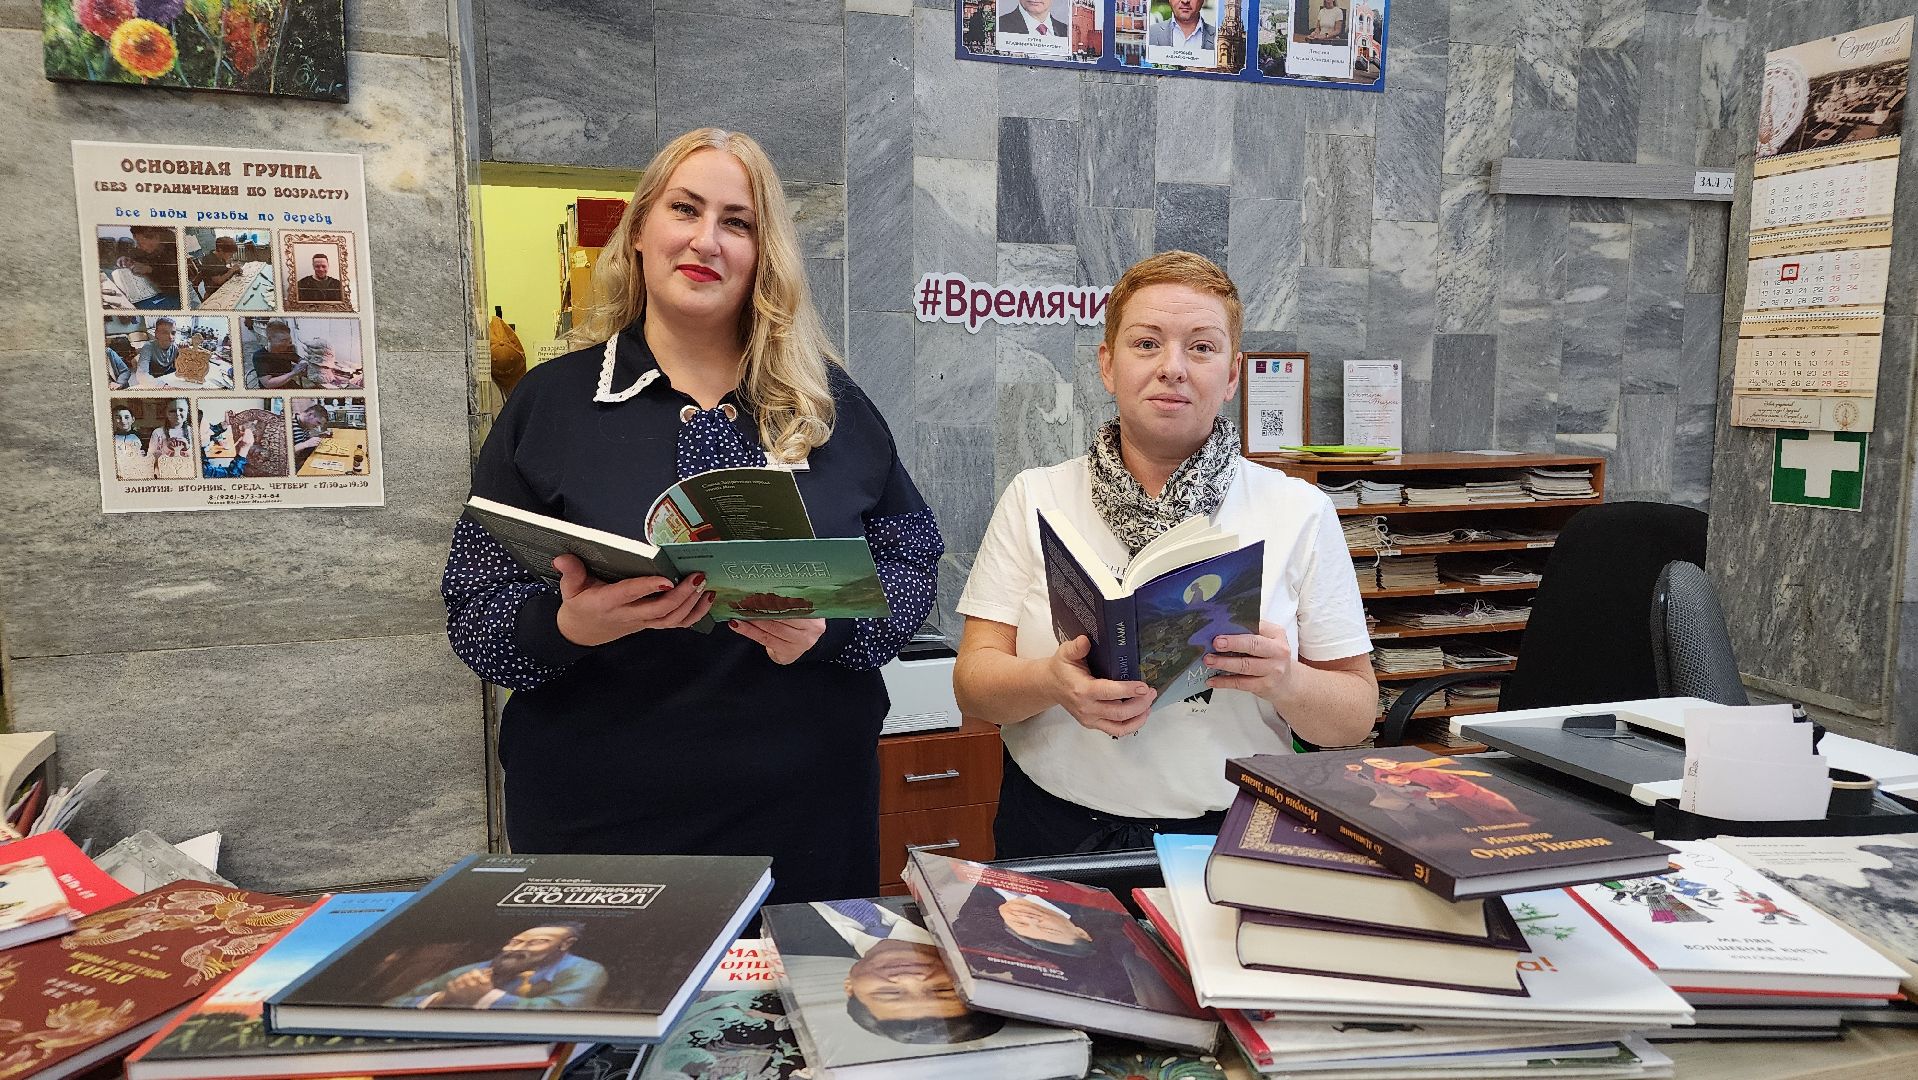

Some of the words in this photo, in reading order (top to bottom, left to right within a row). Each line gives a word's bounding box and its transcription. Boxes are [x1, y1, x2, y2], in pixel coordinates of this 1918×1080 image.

[121, 158, 231, 176] ОСНОВНАЯ
[243, 162, 322, 180] ГРУППА
[1700, 176, 1720, 187] ЗАЛ
[94, 180, 128, 192] (БЕЗ
[135, 182, 239, 196] ОГРАНИЧЕНИЯ
[247, 186, 267, 197] ПО
[274, 186, 349, 201] ВОЗРАСТУ)
[197, 209, 249, 221] резьбы
[258, 212, 275, 222] по
[919, 278, 1109, 328] #Времячи
[125, 485, 173, 493] ЗАНЯТИЯ:
[269, 482, 309, 490] ЧЕТВЕРГ
[349, 480, 369, 488] 19:30
[726, 562, 825, 574] СИЯНИЕ
[1115, 620, 1127, 646] МАМА
[1264, 784, 1285, 803] Оуян
[1285, 795, 1319, 823] История
[1482, 832, 1553, 845] История
[1470, 845, 1537, 860] Оуян
[523, 885, 561, 893] ПУСТЬ
[563, 885, 655, 893] СОПЕРНИЧАЮТ
[513, 892, 564, 904] СТО
[564, 892, 645, 904] ШКОЛ
